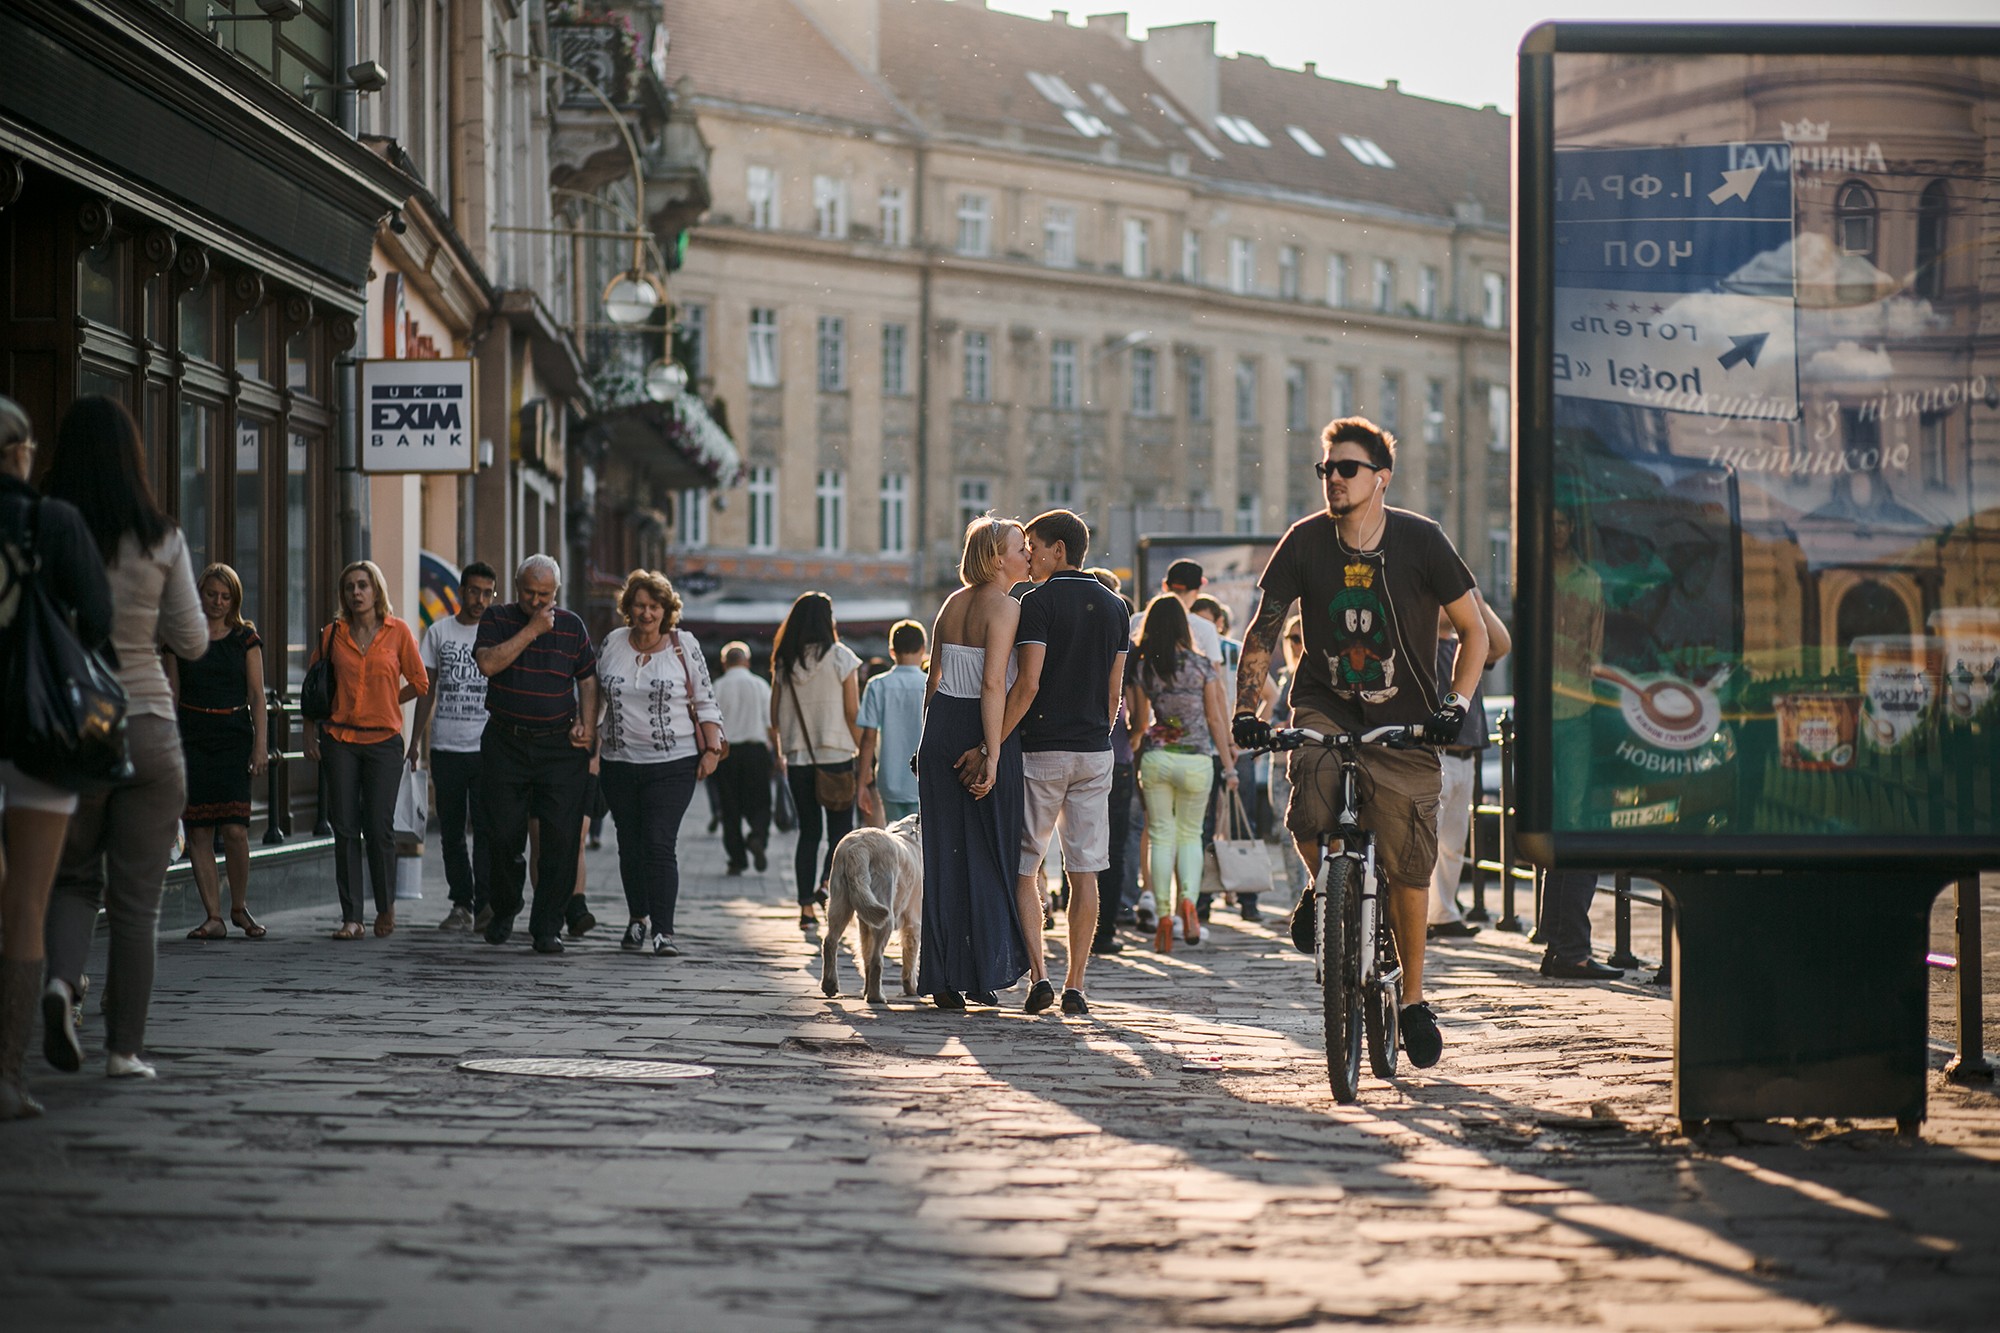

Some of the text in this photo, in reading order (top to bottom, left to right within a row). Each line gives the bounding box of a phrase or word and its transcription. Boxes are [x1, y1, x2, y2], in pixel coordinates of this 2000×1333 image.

[1858, 374, 1987, 423] ніжною
[371, 402, 462, 431] EXIM
[371, 433, 462, 447] BANK
[1615, 740, 1723, 774] НОВИНКА
